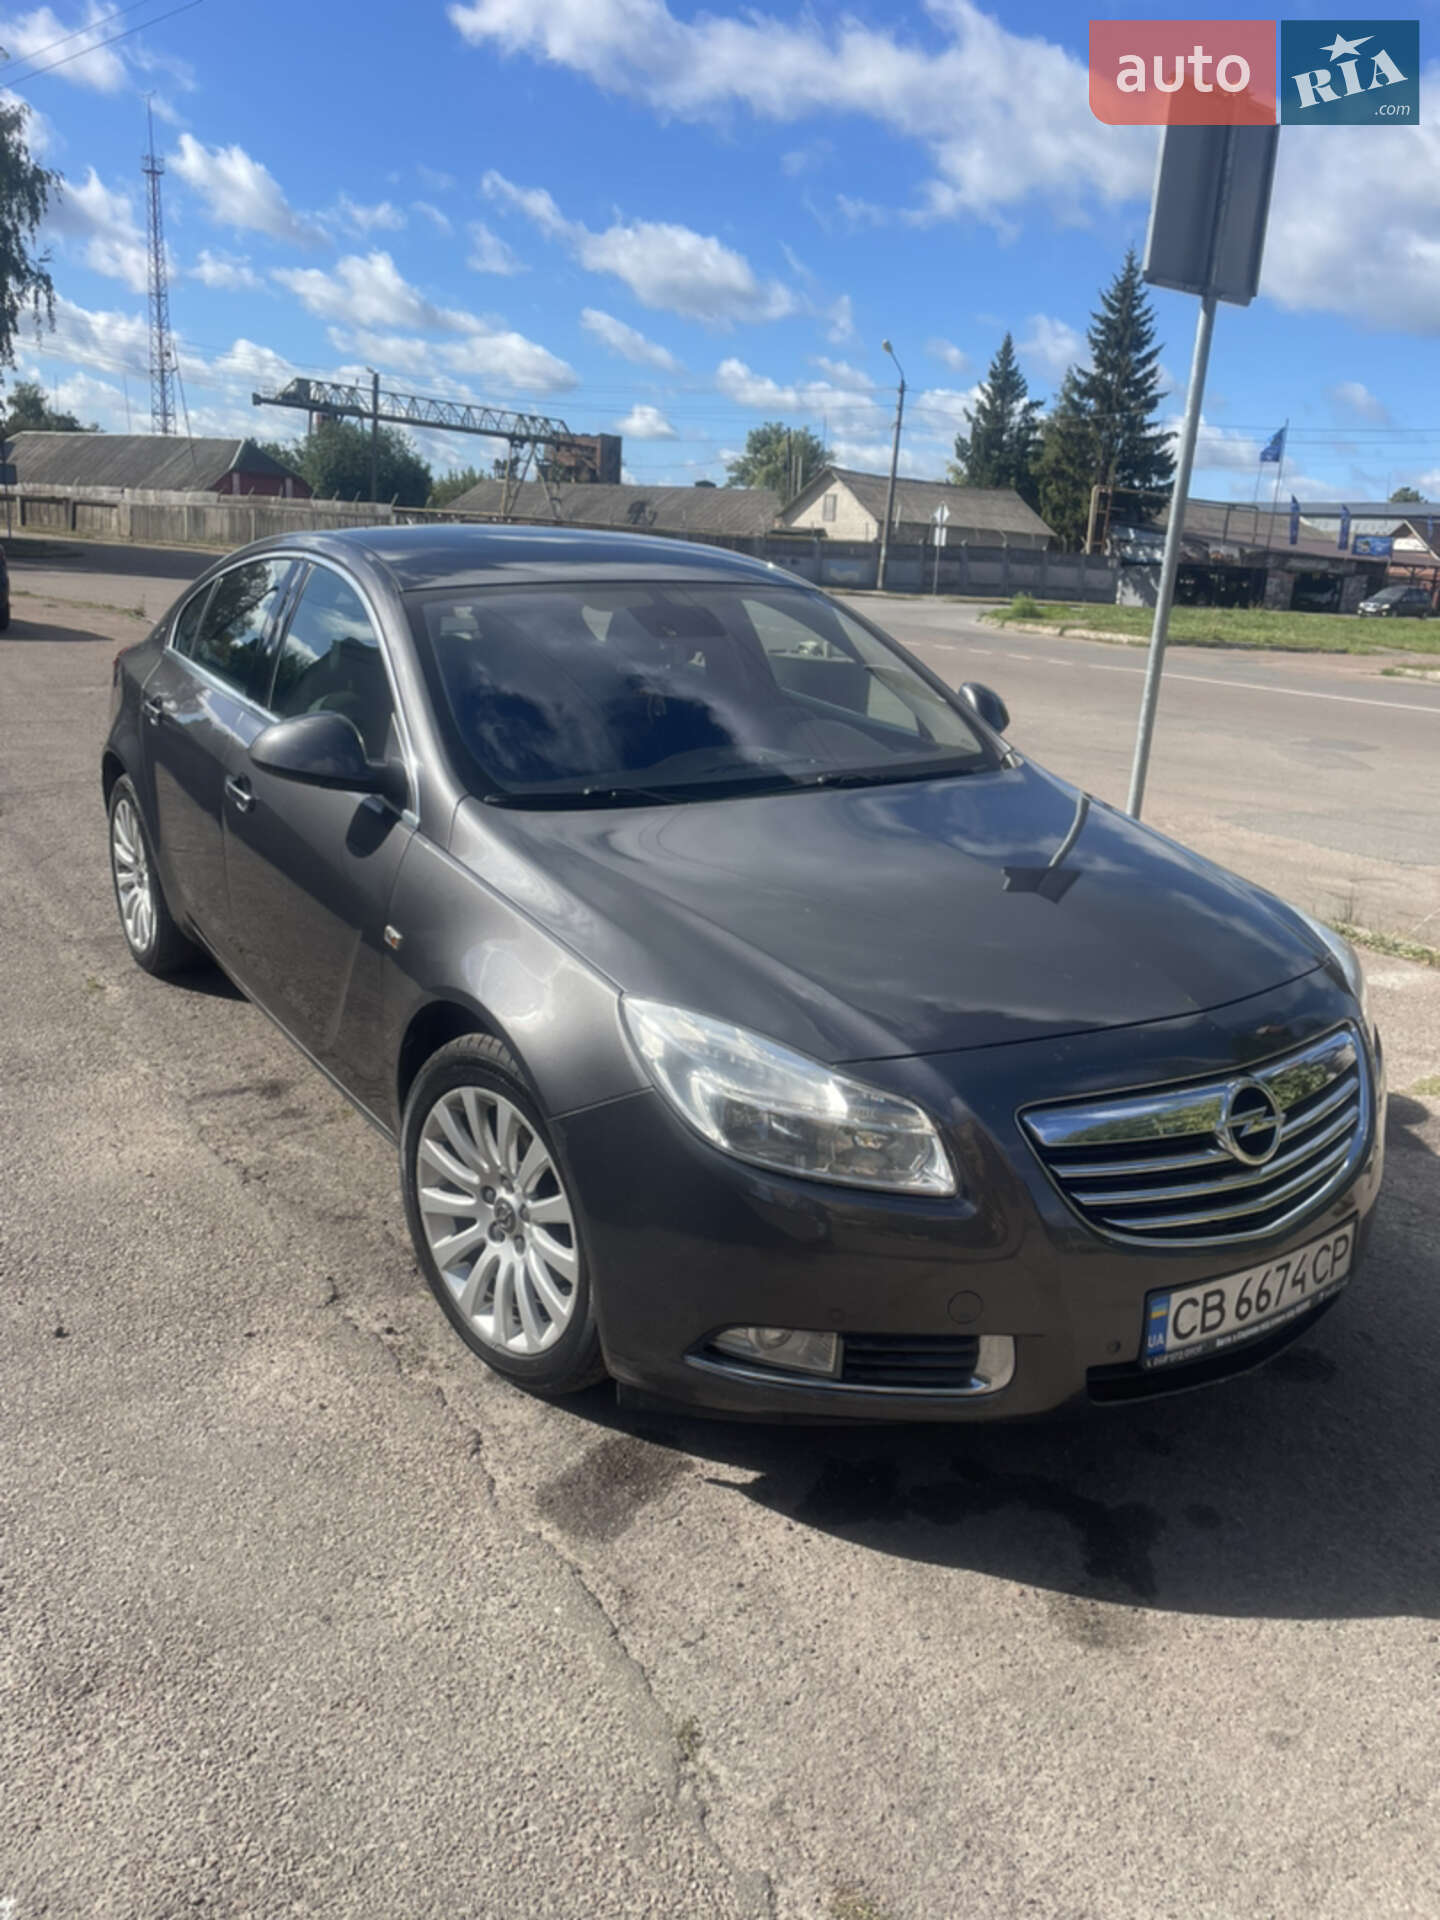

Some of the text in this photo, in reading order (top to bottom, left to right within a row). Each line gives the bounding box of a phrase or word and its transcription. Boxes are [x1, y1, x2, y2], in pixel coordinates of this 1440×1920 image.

[1172, 1288, 1226, 1341] CB
[1235, 1253, 1308, 1321] 6674
[1312, 1234, 1350, 1285] CP
[1147, 1334, 1164, 1348] UA
